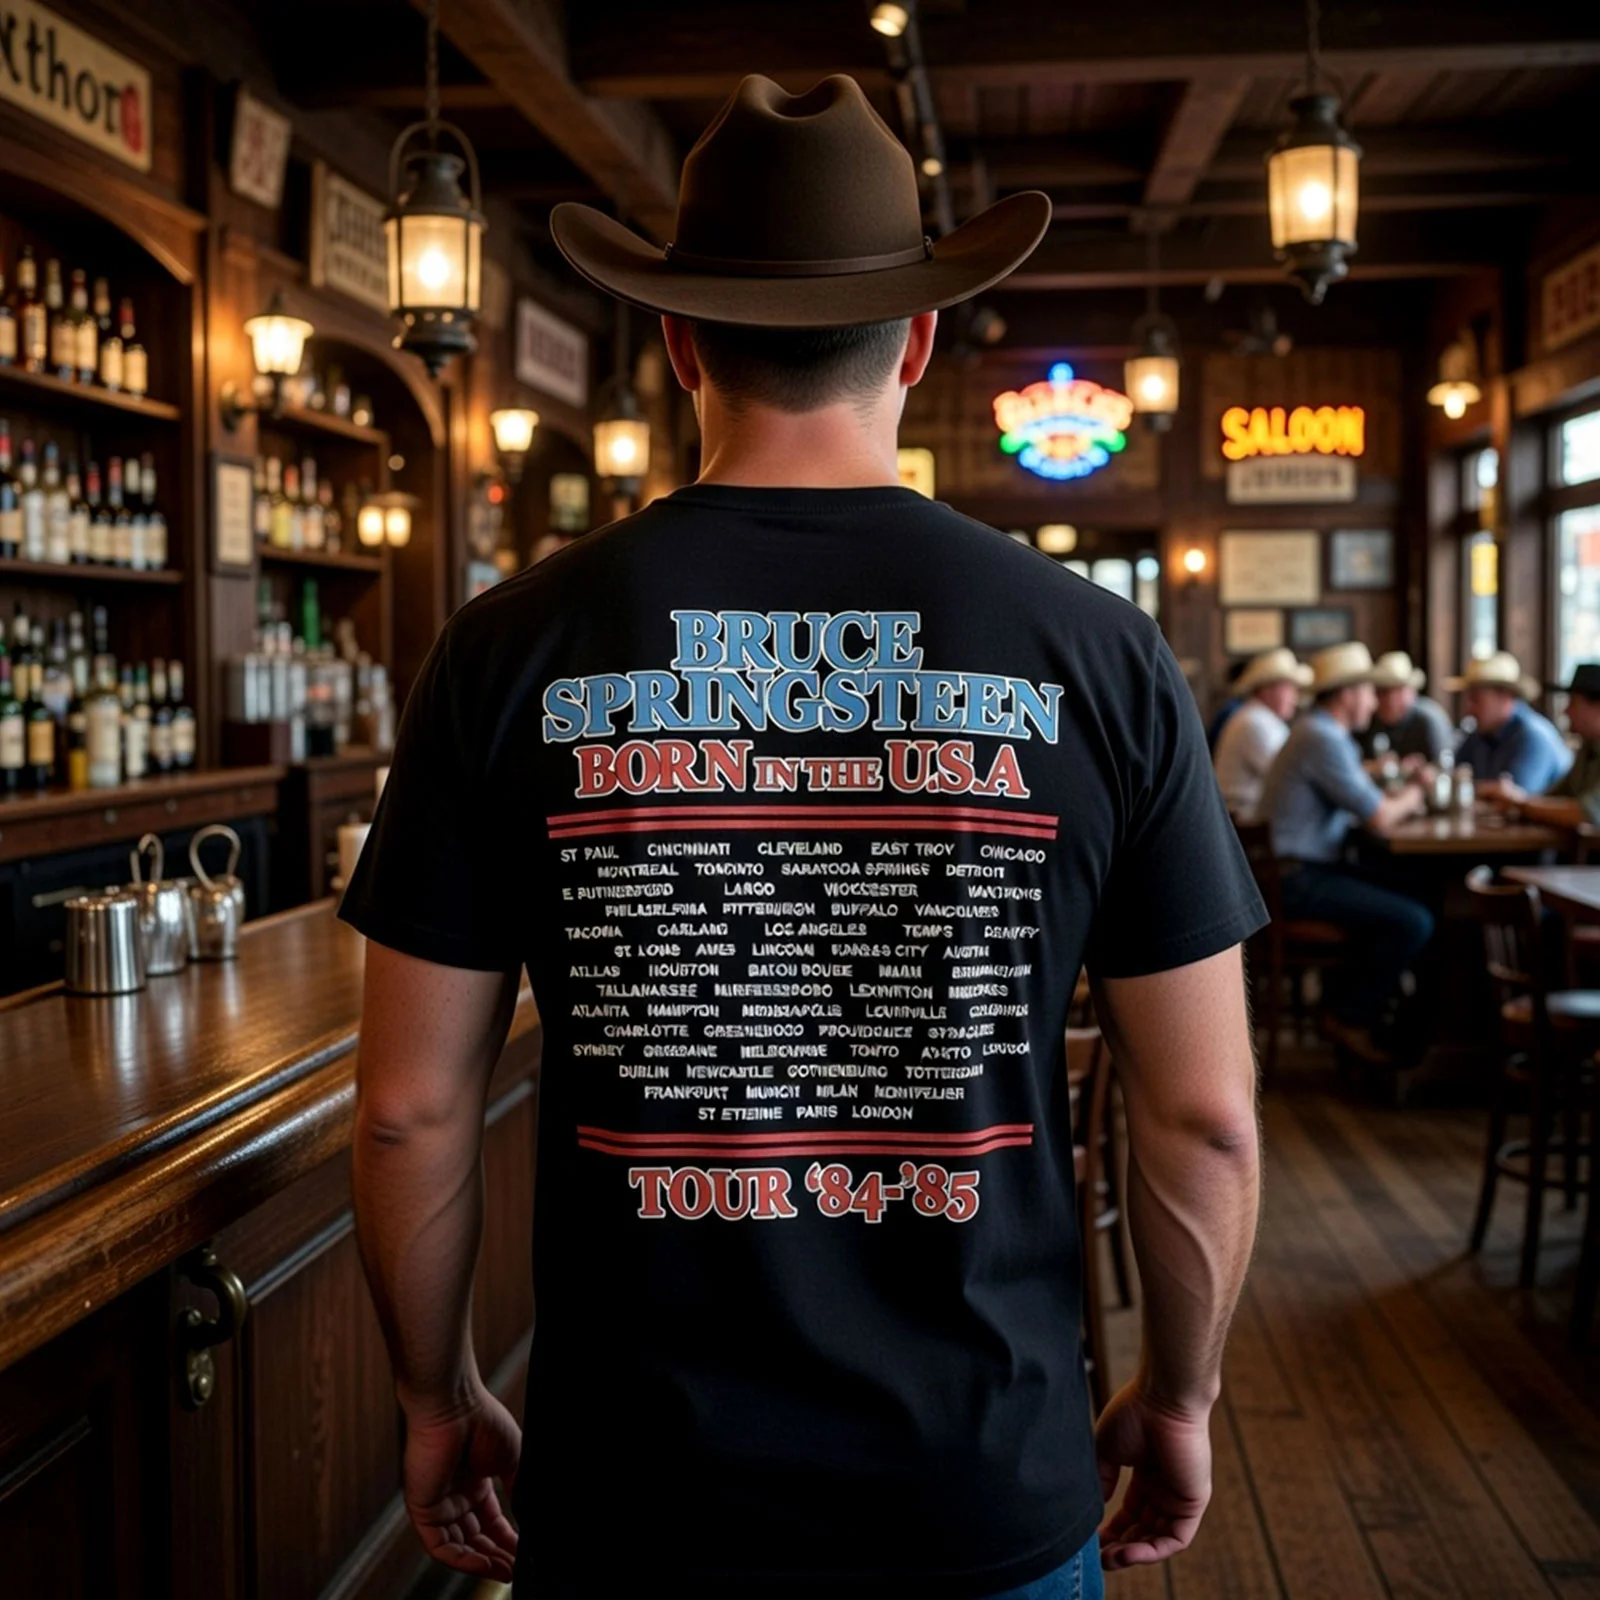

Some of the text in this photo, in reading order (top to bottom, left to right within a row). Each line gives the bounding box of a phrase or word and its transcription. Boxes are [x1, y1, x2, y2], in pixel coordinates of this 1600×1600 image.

[1221, 405, 1365, 460] SALOON
[671, 610, 923, 671] BRUCE
[542, 669, 1065, 745] SPRINGSTEEN
[574, 739, 754, 799] BORN
[753, 758, 801, 792] IN
[801, 757, 883, 792] THE
[560, 848, 578, 863] ST
[871, 842, 909, 857] EAST
[894, 944, 929, 957] CITY
[698, 1107, 716, 1121] ST
[628, 1166, 798, 1220] TOUR
